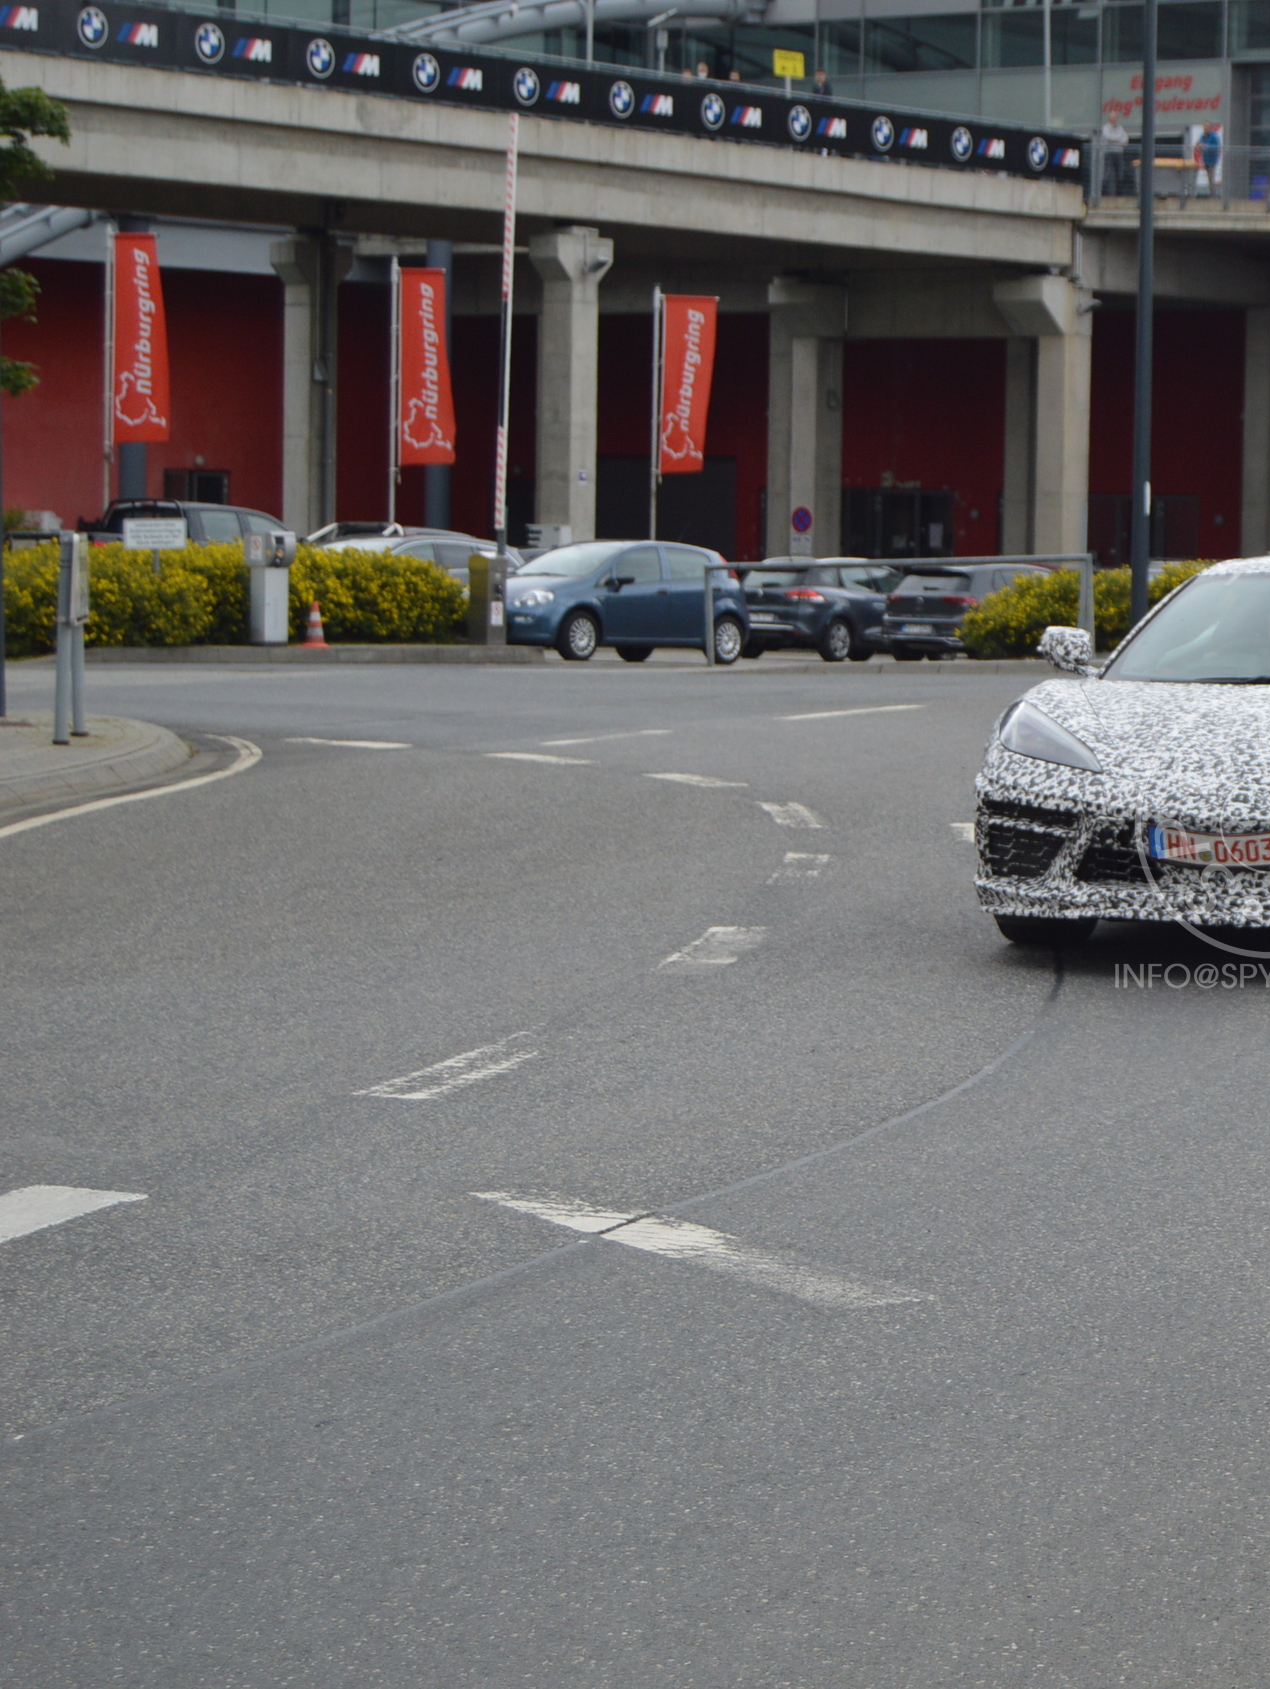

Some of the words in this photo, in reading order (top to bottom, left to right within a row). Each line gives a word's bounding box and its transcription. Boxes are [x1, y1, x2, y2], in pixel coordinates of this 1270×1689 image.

[1130, 75, 1192, 92] Eigang
[133, 248, 156, 395] nürburgring
[418, 282, 440, 420] nürburgring
[676, 308, 705, 432] nürburgring
